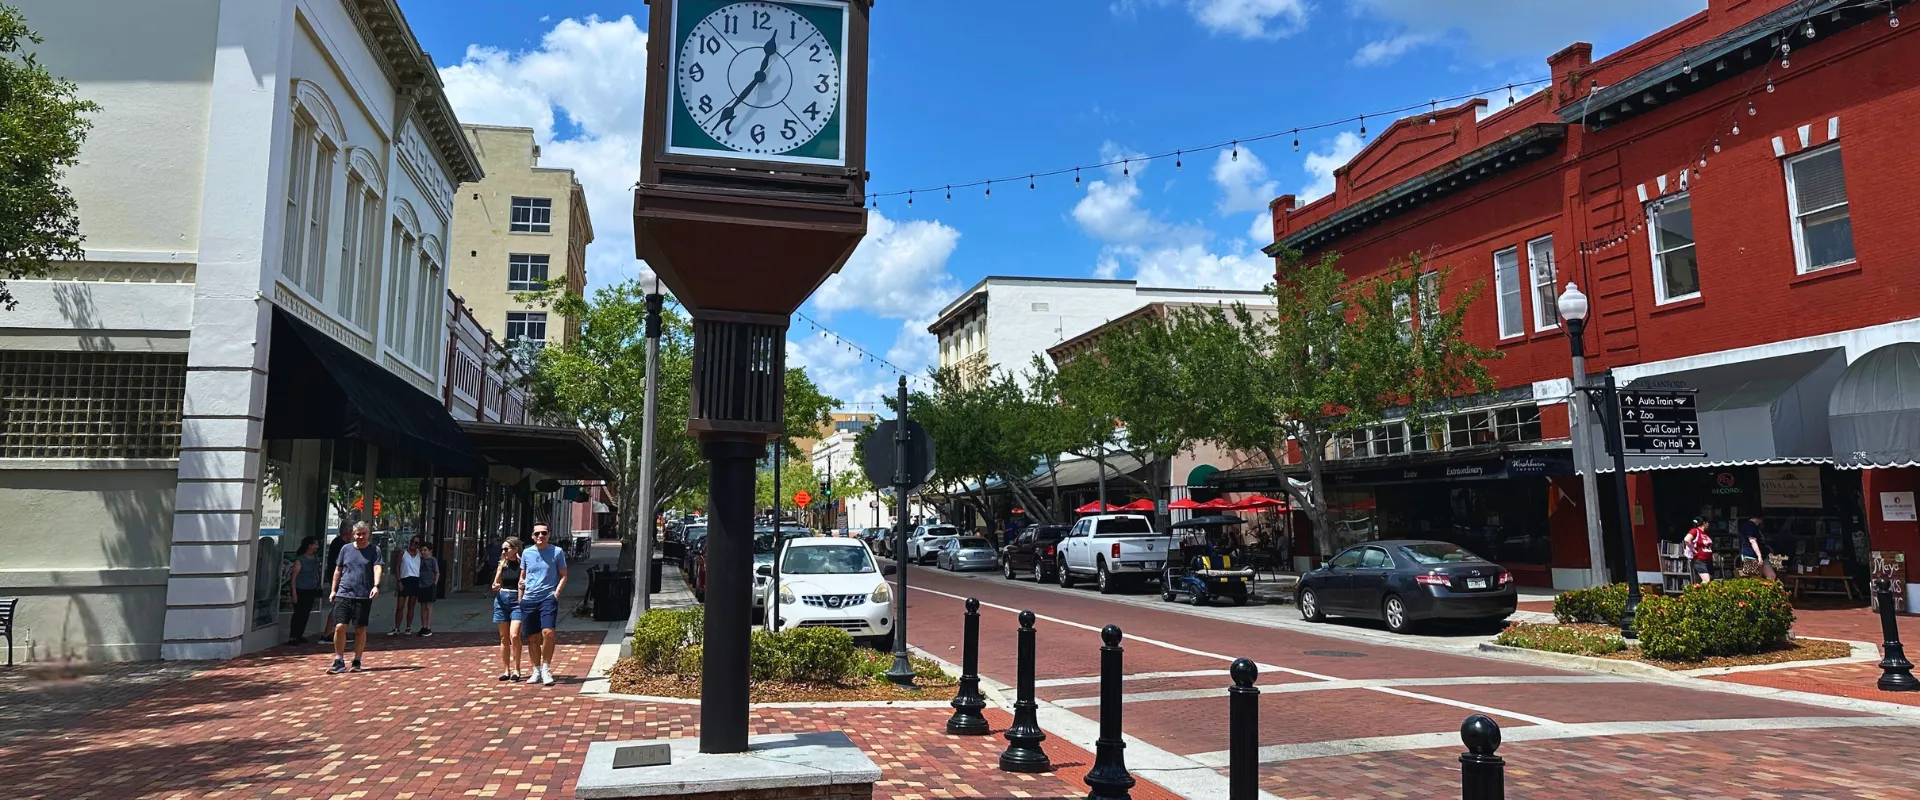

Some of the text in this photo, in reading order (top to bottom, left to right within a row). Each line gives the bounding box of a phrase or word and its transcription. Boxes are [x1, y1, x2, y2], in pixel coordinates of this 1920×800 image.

[723, 13, 739, 35] 11
[752, 9, 773, 31] 12
[790, 20, 797, 41] 1
[698, 33, 721, 56] 10
[809, 43, 822, 63] 2
[688, 61, 705, 83] 9
[813, 73, 830, 94] 3
[698, 93, 713, 115] 8
[802, 100, 821, 122] 4
[750, 123, 766, 146] 6
[779, 118, 798, 140] 5
[1638, 396, 1674, 406] Auto Train
[1640, 410, 1655, 420] Zoo
[1644, 424, 1681, 434] Civil Court
[1652, 438, 1683, 451] City Hall
[1446, 466, 1483, 477] Extraordinary
[1512, 459, 1546, 467] Washburn
[1872, 557, 1900, 578] Maya
